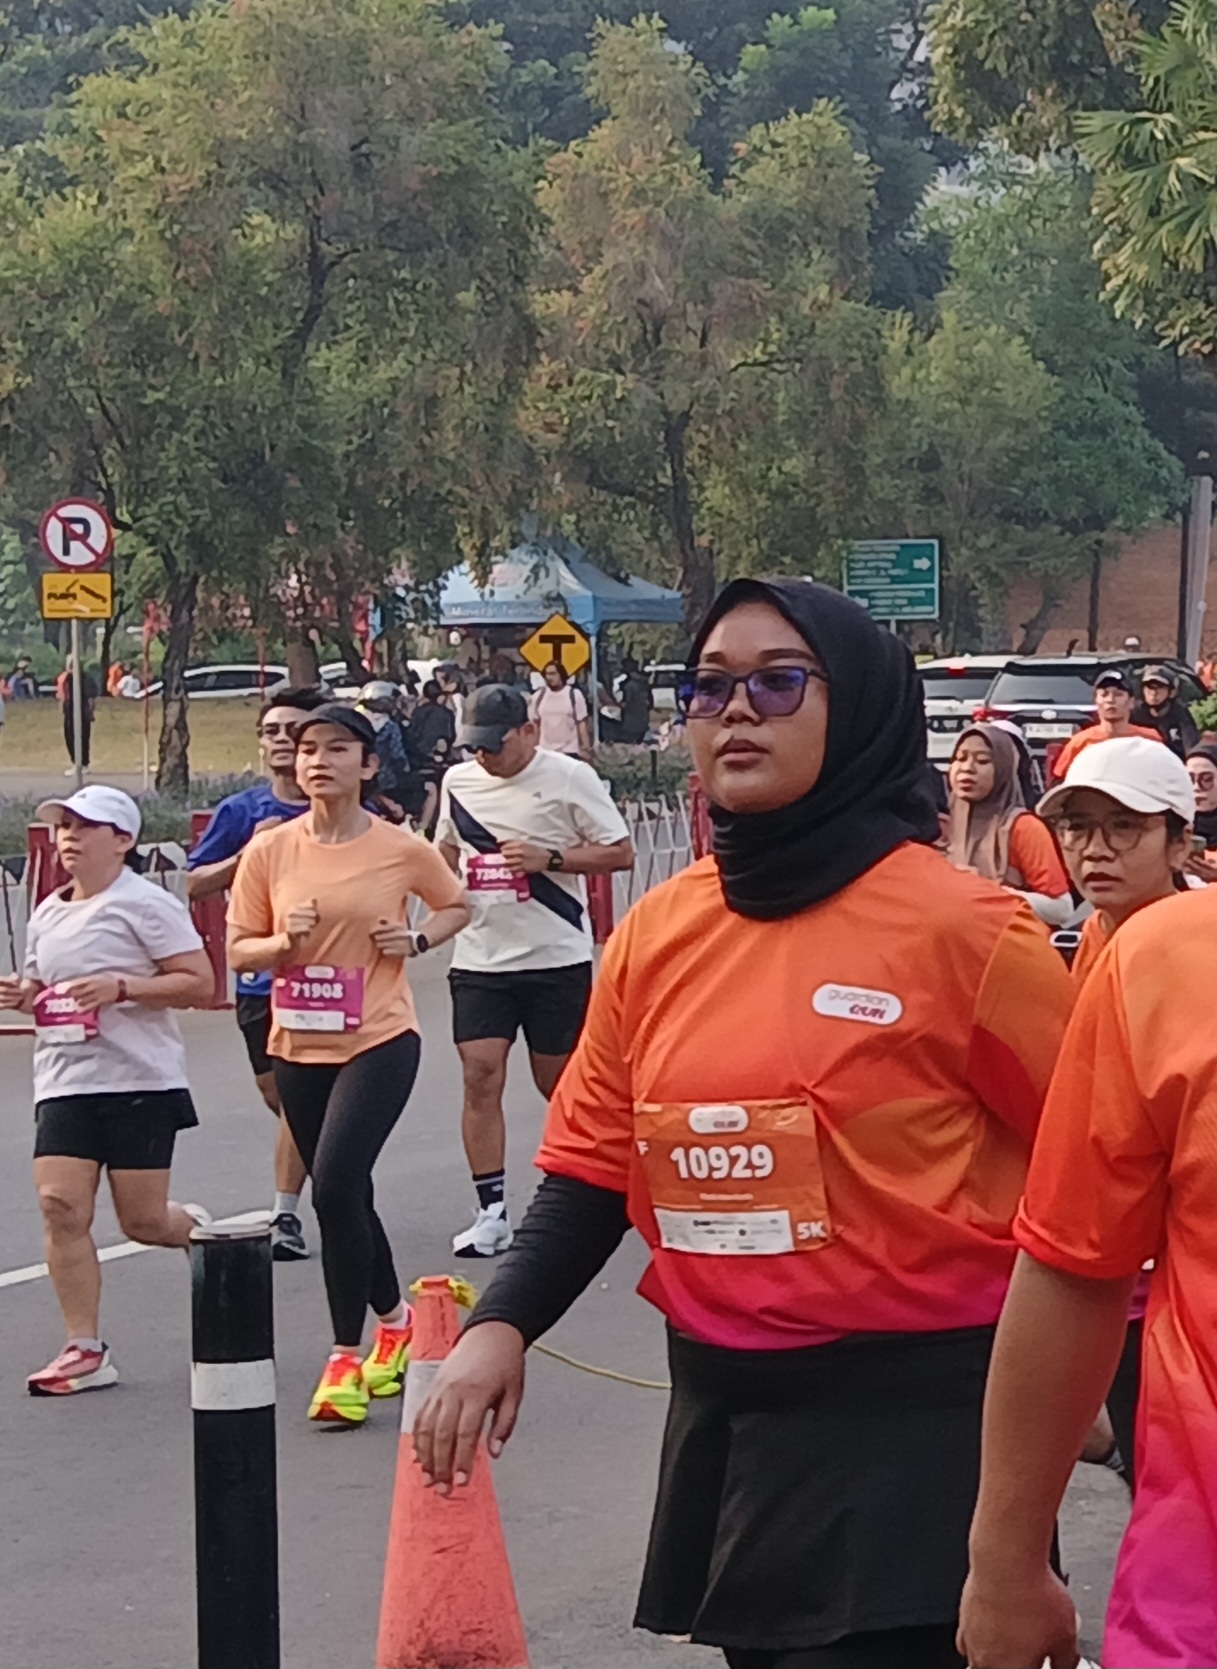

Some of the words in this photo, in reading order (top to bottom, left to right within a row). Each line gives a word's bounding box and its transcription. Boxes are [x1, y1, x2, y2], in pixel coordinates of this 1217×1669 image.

[290, 981, 344, 999] 71908
[828, 989, 890, 1006] guardian
[849, 1004, 886, 1019] RUN
[670, 1144, 774, 1179] 10929
[797, 1221, 826, 1240] 5K
